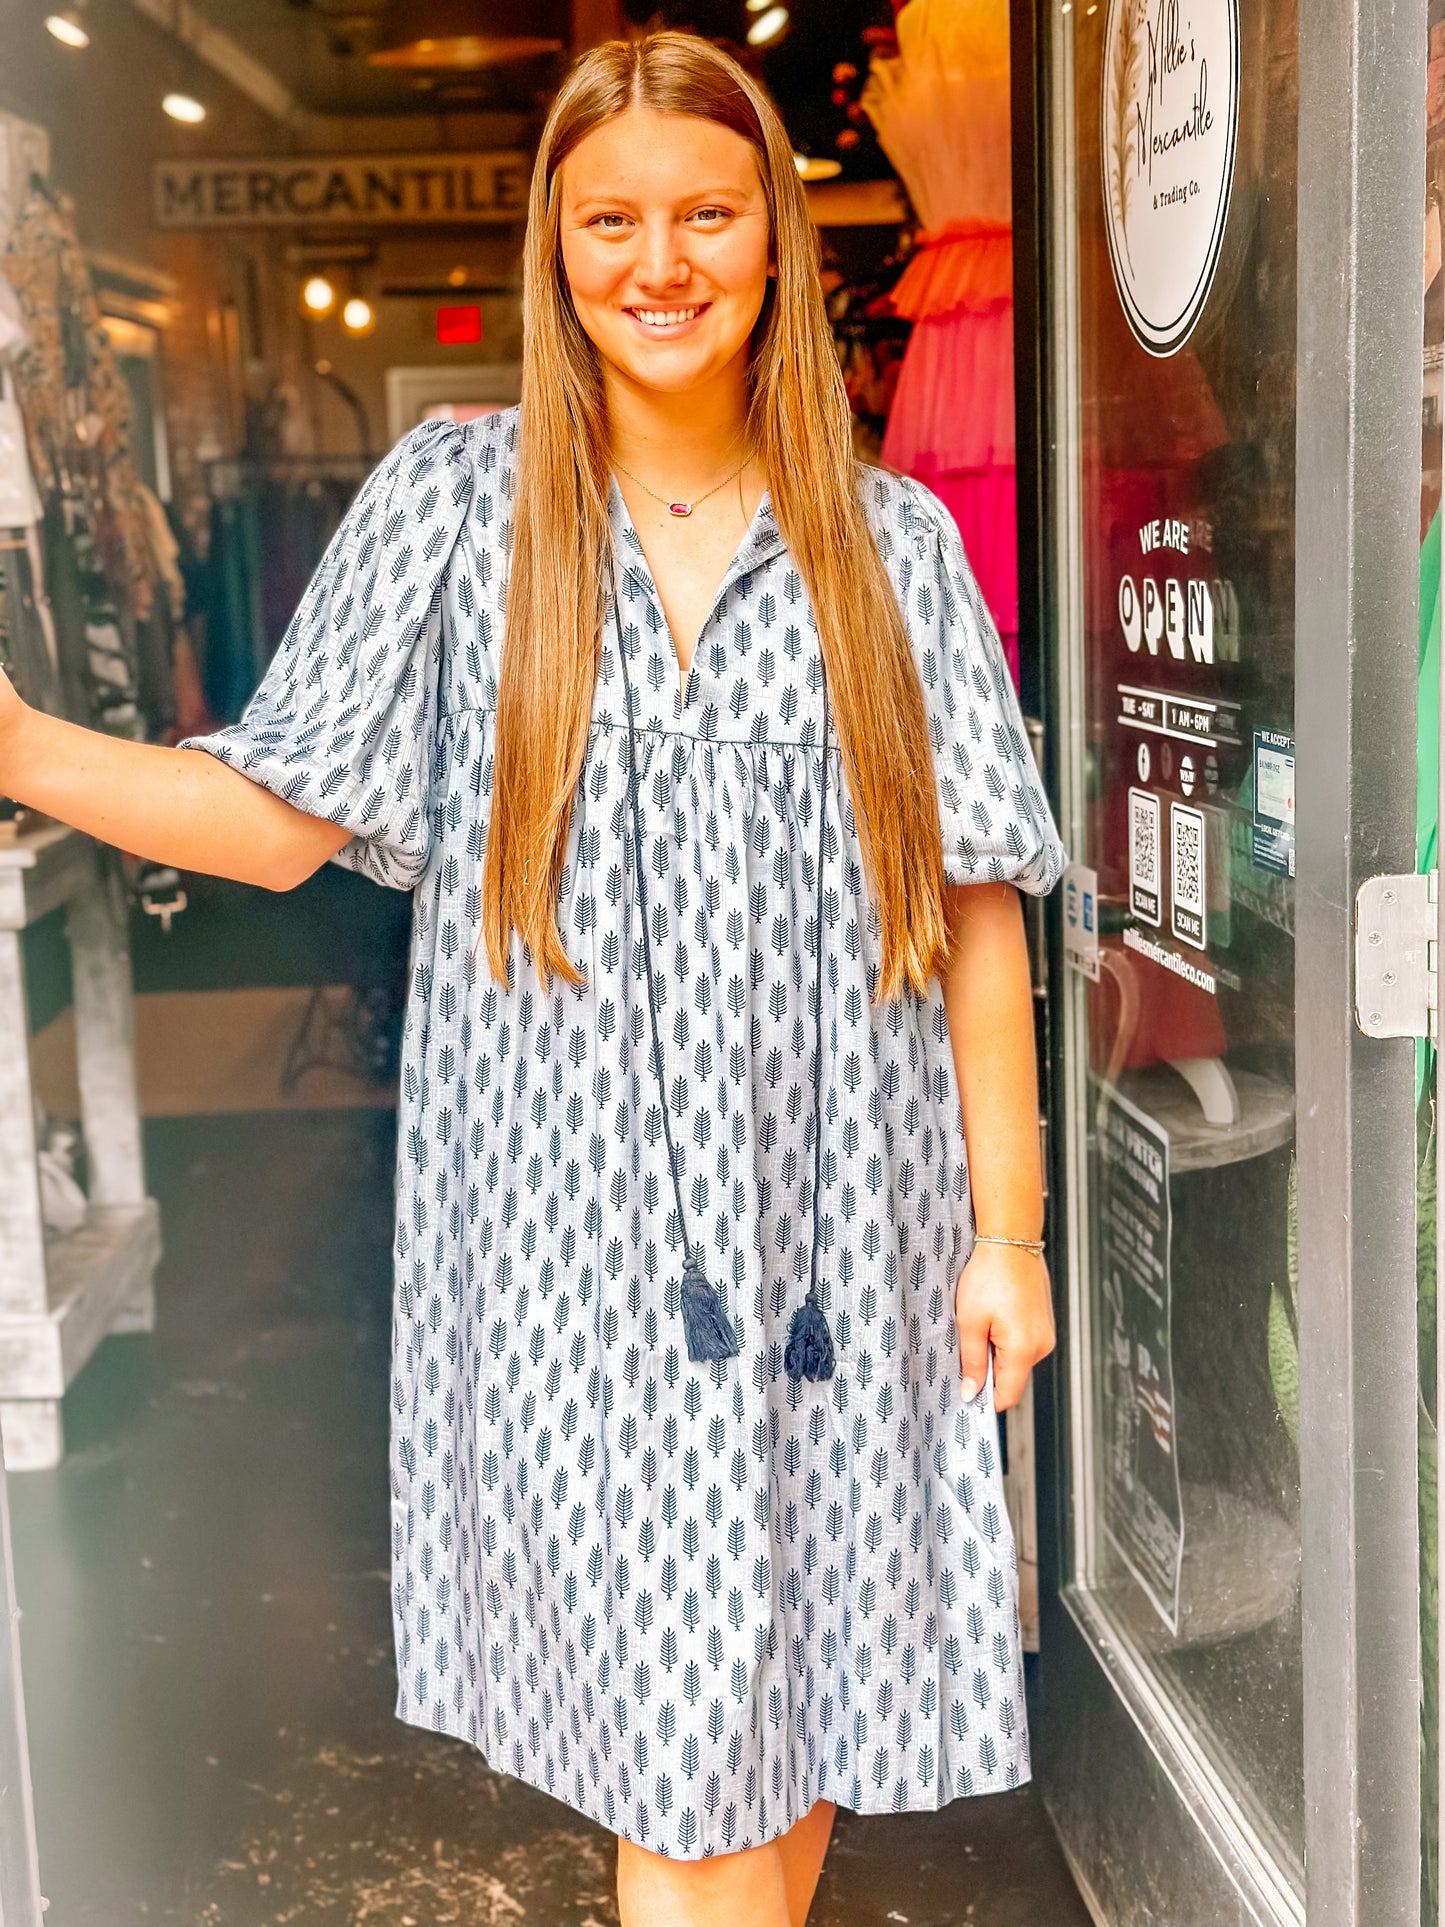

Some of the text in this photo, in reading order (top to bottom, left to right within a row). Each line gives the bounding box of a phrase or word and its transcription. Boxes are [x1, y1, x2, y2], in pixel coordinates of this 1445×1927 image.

[1147, 0, 1195, 106] Millie's
[1136, 58, 1213, 187] Mercantile
[162, 167, 523, 216] MERCANTILE
[1152, 180, 1201, 210] & Trading Co.
[1139, 519, 1161, 555] WE
[1162, 518, 1190, 555] ARE
[1118, 574, 1215, 664] OPEN
[1270, 732, 1290, 749] ACCEPT
[1134, 890, 1156, 915] SCAN ME
[1176, 911, 1201, 937] SCAN ME
